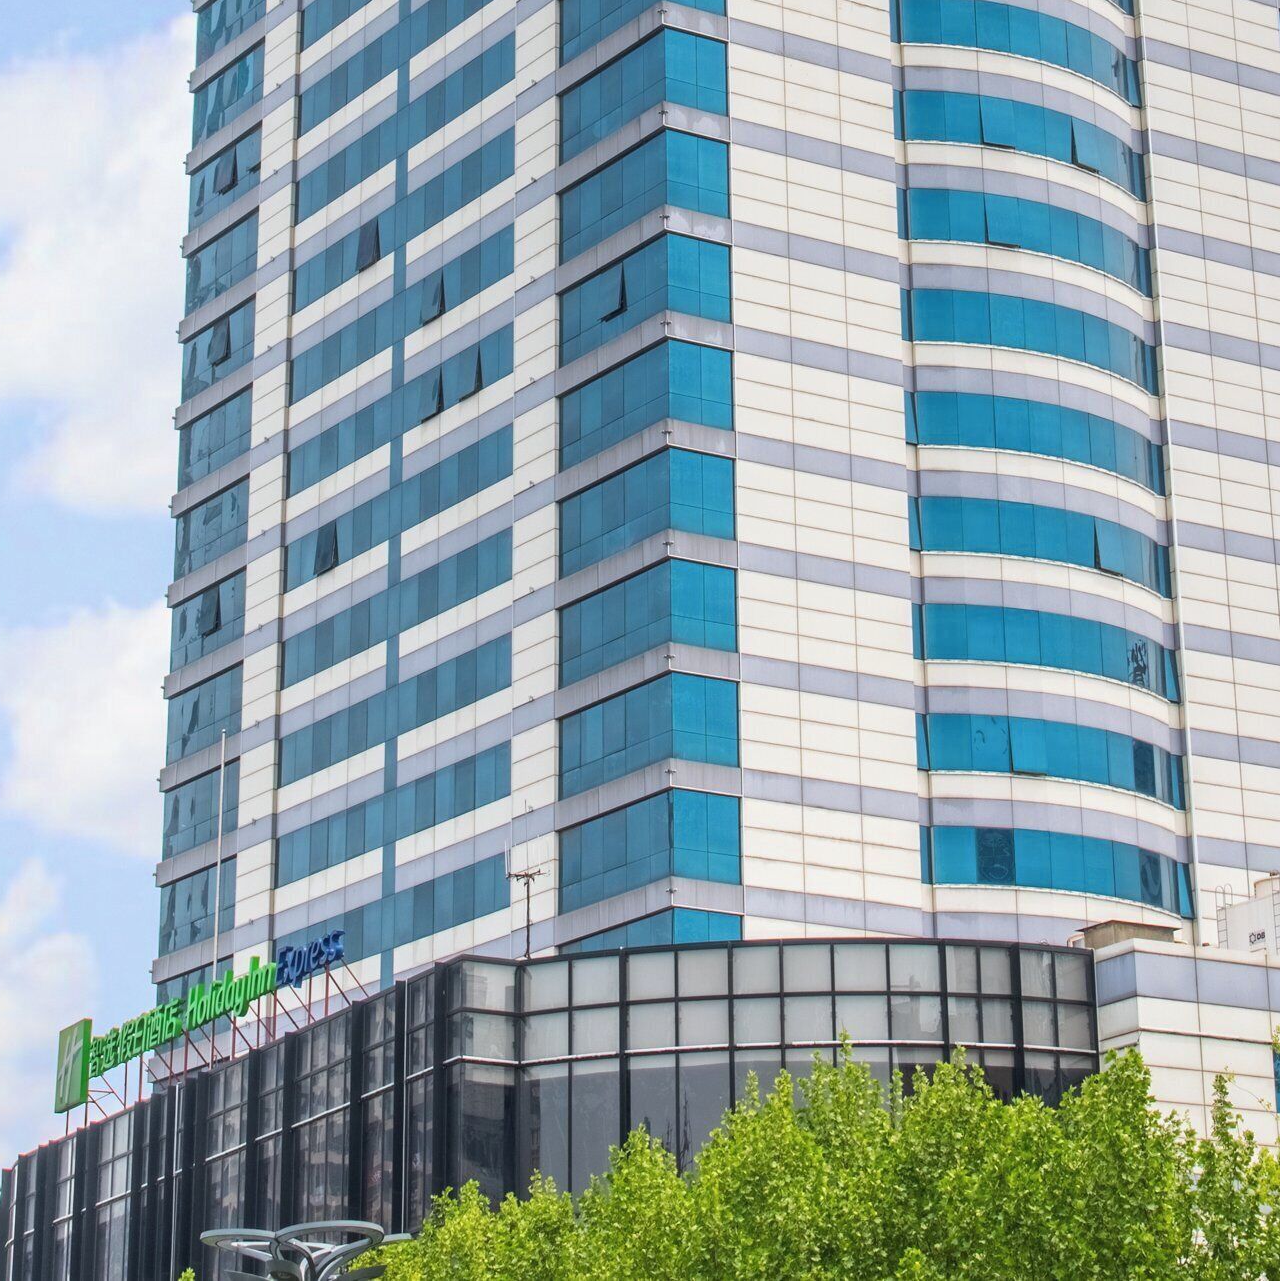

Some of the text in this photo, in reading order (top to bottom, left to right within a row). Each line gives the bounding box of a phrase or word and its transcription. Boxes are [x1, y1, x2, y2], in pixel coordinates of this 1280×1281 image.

[275, 930, 346, 989] Express
[88, 998, 184, 1079] 智选假日酒店
